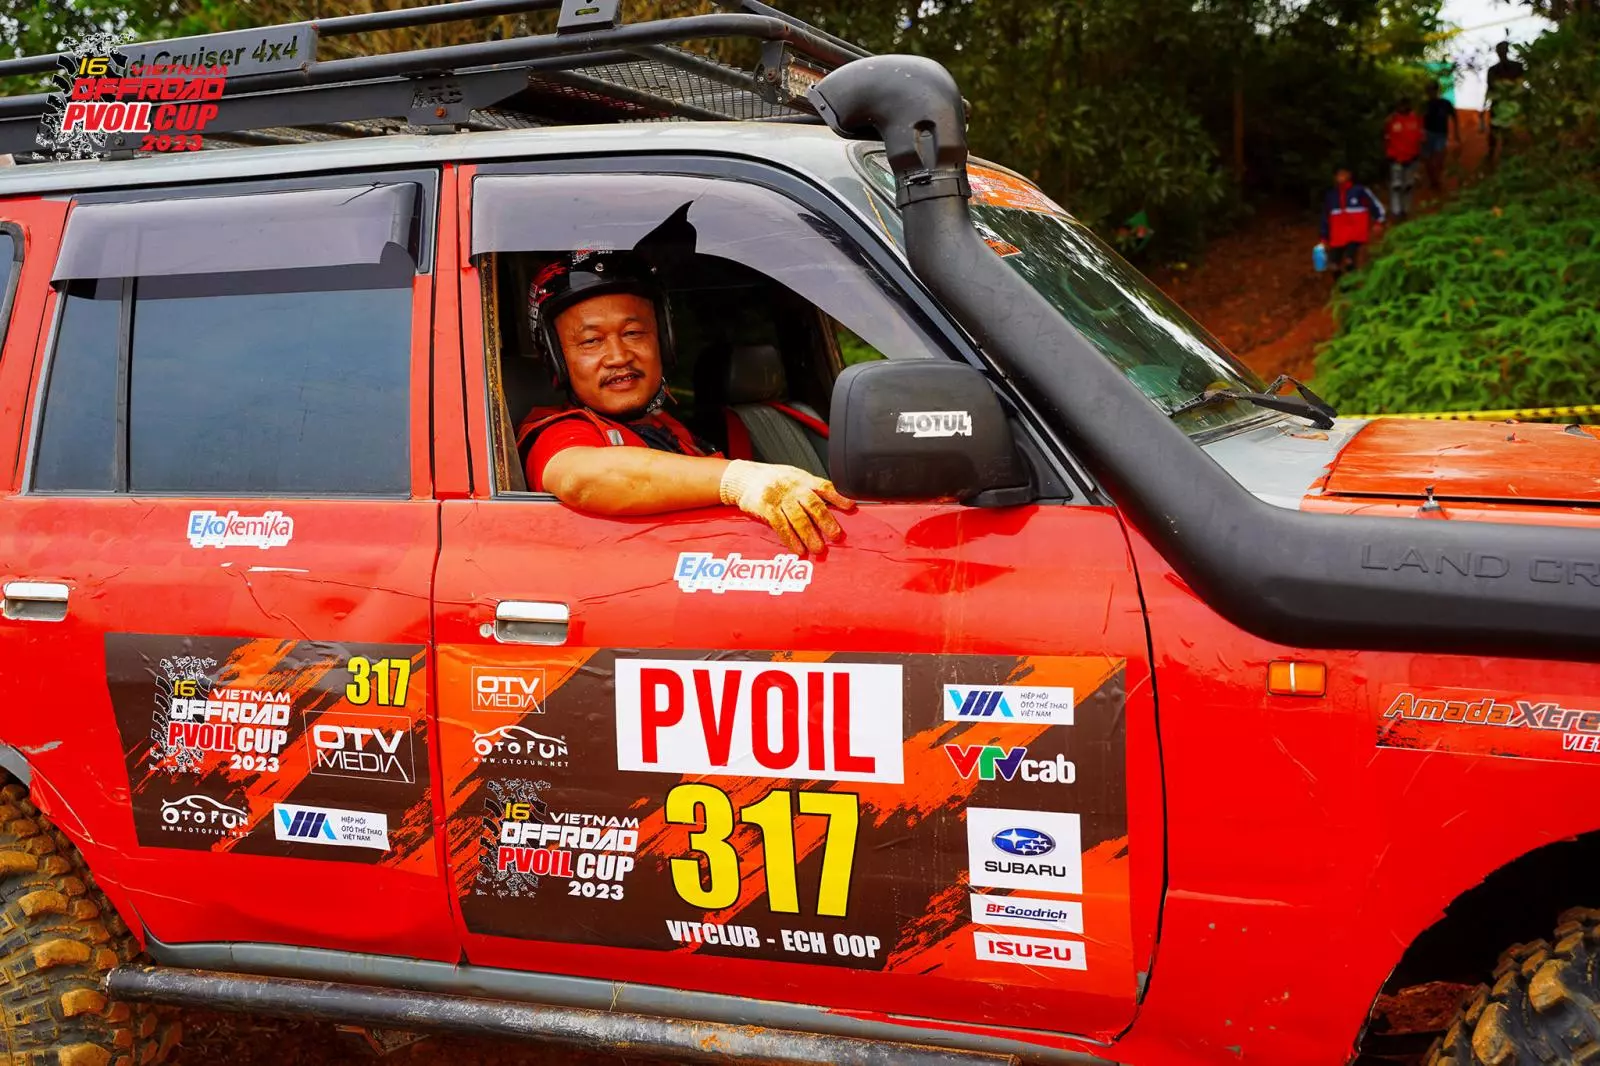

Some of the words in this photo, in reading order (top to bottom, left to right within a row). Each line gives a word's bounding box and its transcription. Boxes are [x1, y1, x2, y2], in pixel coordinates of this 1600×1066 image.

[152, 45, 246, 74] Cruiser
[252, 35, 299, 64] 4x4
[896, 414, 968, 433] MOTUL
[191, 514, 290, 538] Ekokemika
[679, 557, 809, 583] Ekokemika
[1361, 544, 1510, 579] LAND
[173, 680, 196, 697] 16
[346, 656, 411, 706] 317
[477, 676, 540, 693] OTV
[213, 688, 291, 702] VIETNAM
[478, 693, 541, 713] MEDIA
[171, 699, 290, 726] OFFROAD
[640, 667, 876, 774] PVOIL
[168, 722, 236, 753] PVOIL
[236, 727, 288, 754] CUP
[313, 724, 404, 754] OTV
[474, 738, 568, 759] OTOFUN
[230, 754, 280, 773] 2023
[317, 751, 411, 783] MEDIA
[473, 757, 569, 767] WWW.OTOFUN.NET
[162, 807, 248, 829] OTOFUN
[505, 803, 530, 820] 16
[550, 812, 639, 828] VIETNAM
[367, 828, 383, 836] THAO
[500, 822, 639, 852] OFFROAD
[664, 782, 859, 918] 317
[498, 847, 573, 878] PVOIL
[577, 853, 634, 882] CUP
[985, 861, 1066, 877] SUBARU
[567, 881, 624, 900] 2023
[986, 904, 1067, 920] BFGoodrich
[665, 919, 760, 949] VITCLUB
[781, 929, 827, 954] ECH
[988, 940, 1071, 961] ISUZU
